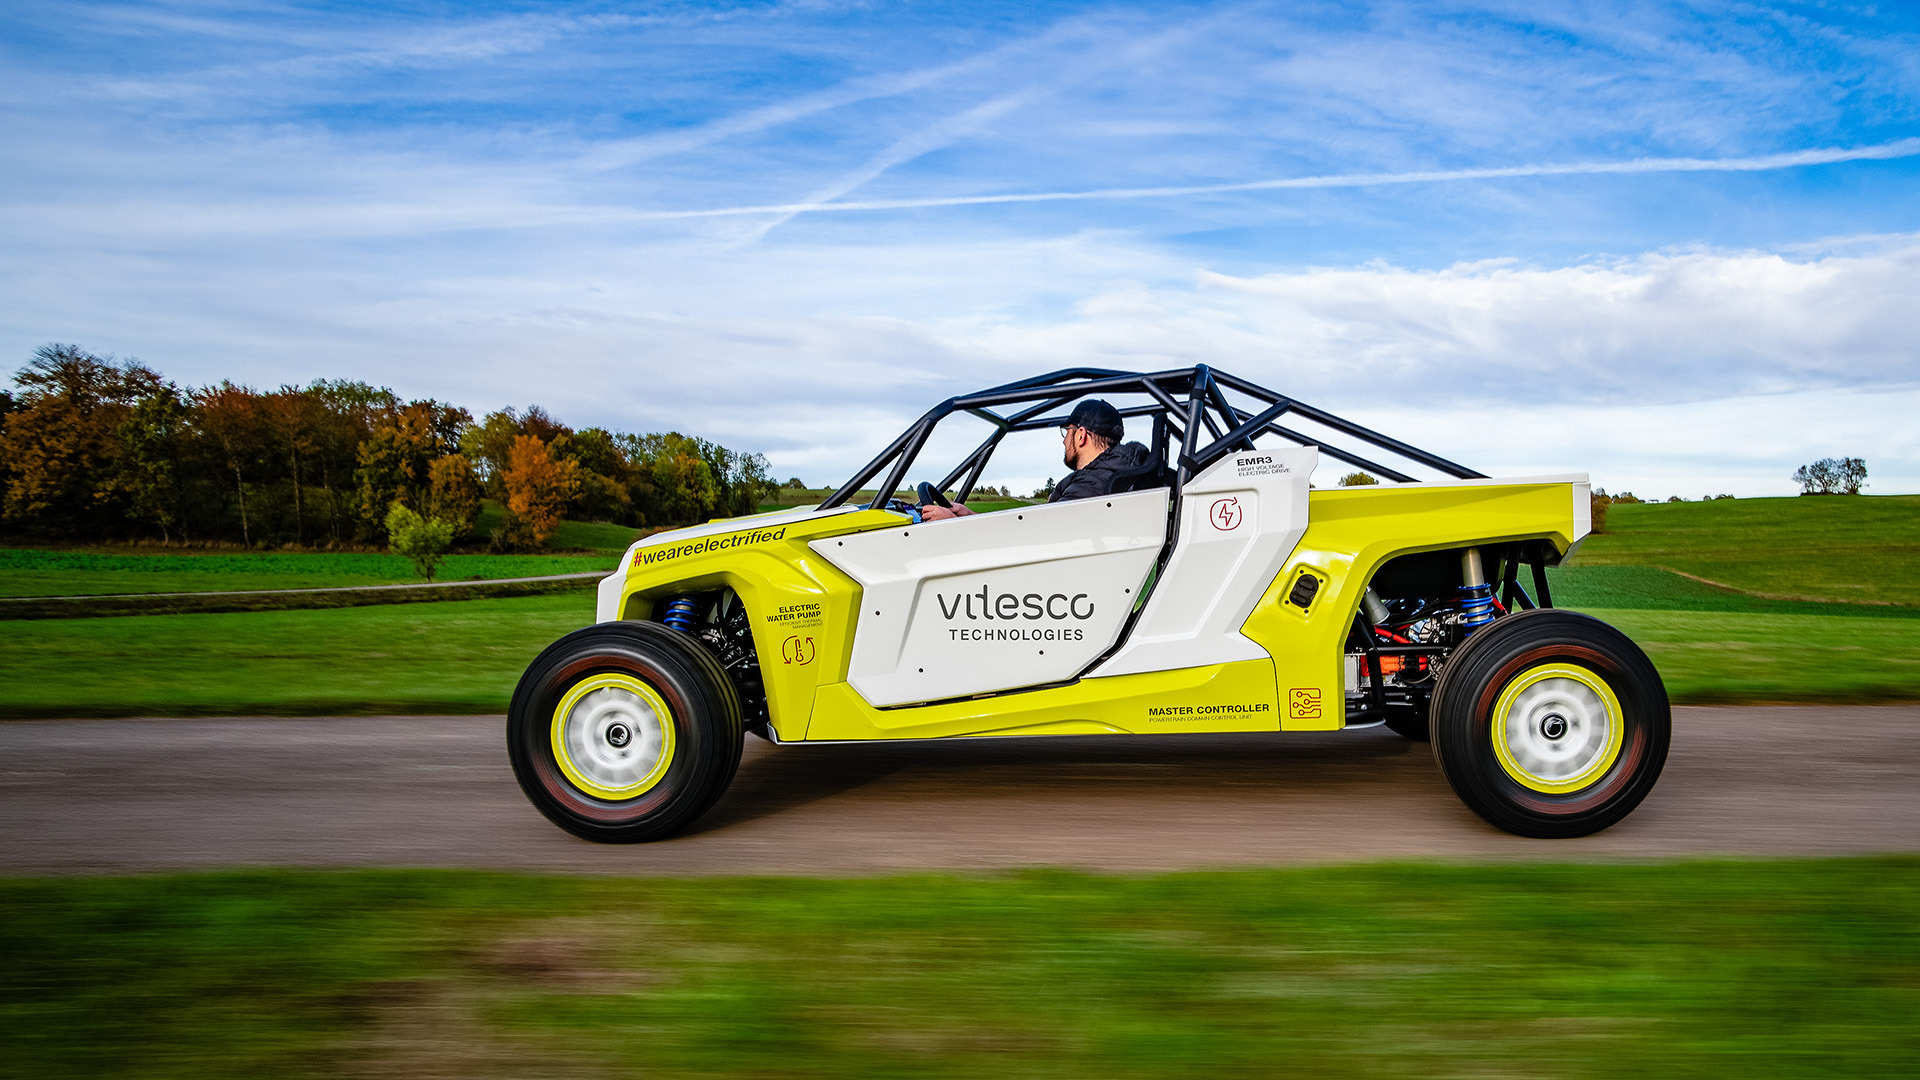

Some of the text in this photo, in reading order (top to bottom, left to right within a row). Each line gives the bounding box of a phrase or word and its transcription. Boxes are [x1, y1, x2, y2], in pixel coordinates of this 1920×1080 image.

[1237, 456, 1273, 466] EMR3
[633, 527, 787, 567] #weareelectrified
[779, 603, 820, 613] ELECTRIC
[936, 584, 1095, 620] vitesco
[766, 611, 822, 622] WATER PUMP
[948, 629, 1084, 641] TECHNOLOGIES
[1148, 703, 1270, 716] MASTER CONTROLLER
